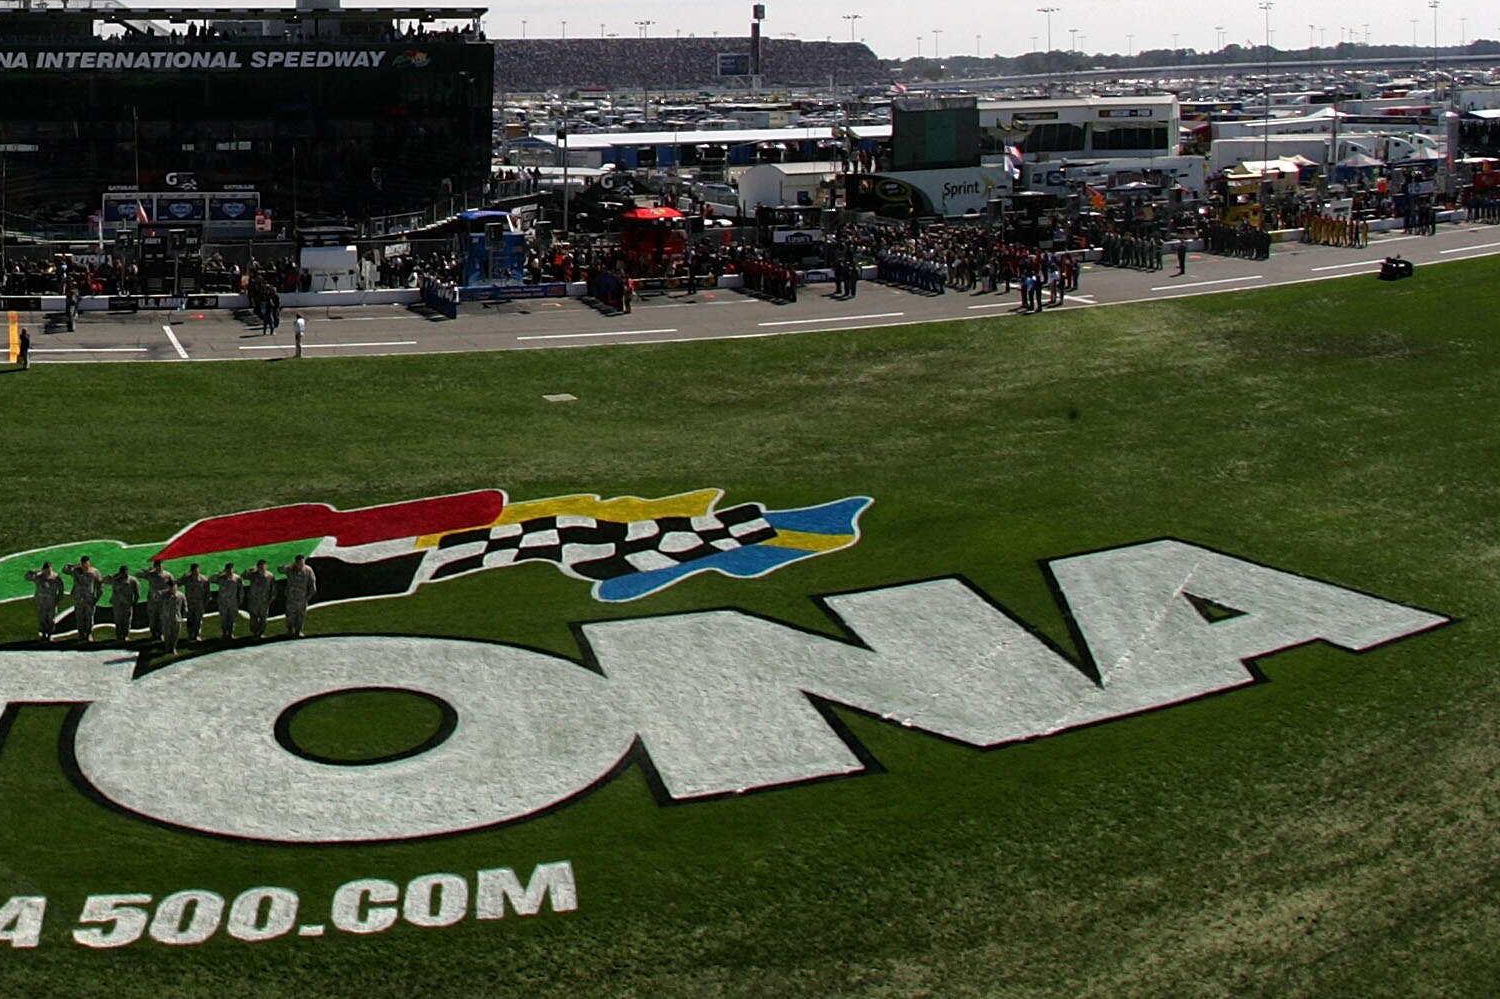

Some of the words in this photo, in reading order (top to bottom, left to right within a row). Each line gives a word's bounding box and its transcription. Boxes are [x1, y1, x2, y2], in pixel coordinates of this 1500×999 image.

[36, 52, 242, 68] INTERNATIONAL
[250, 50, 387, 68] SPEEDWAY
[943, 181, 980, 197] Sprint
[138, 298, 158, 308] U.S.
[159, 298, 188, 308] ARMY
[72, 861, 577, 947] 500.COM
